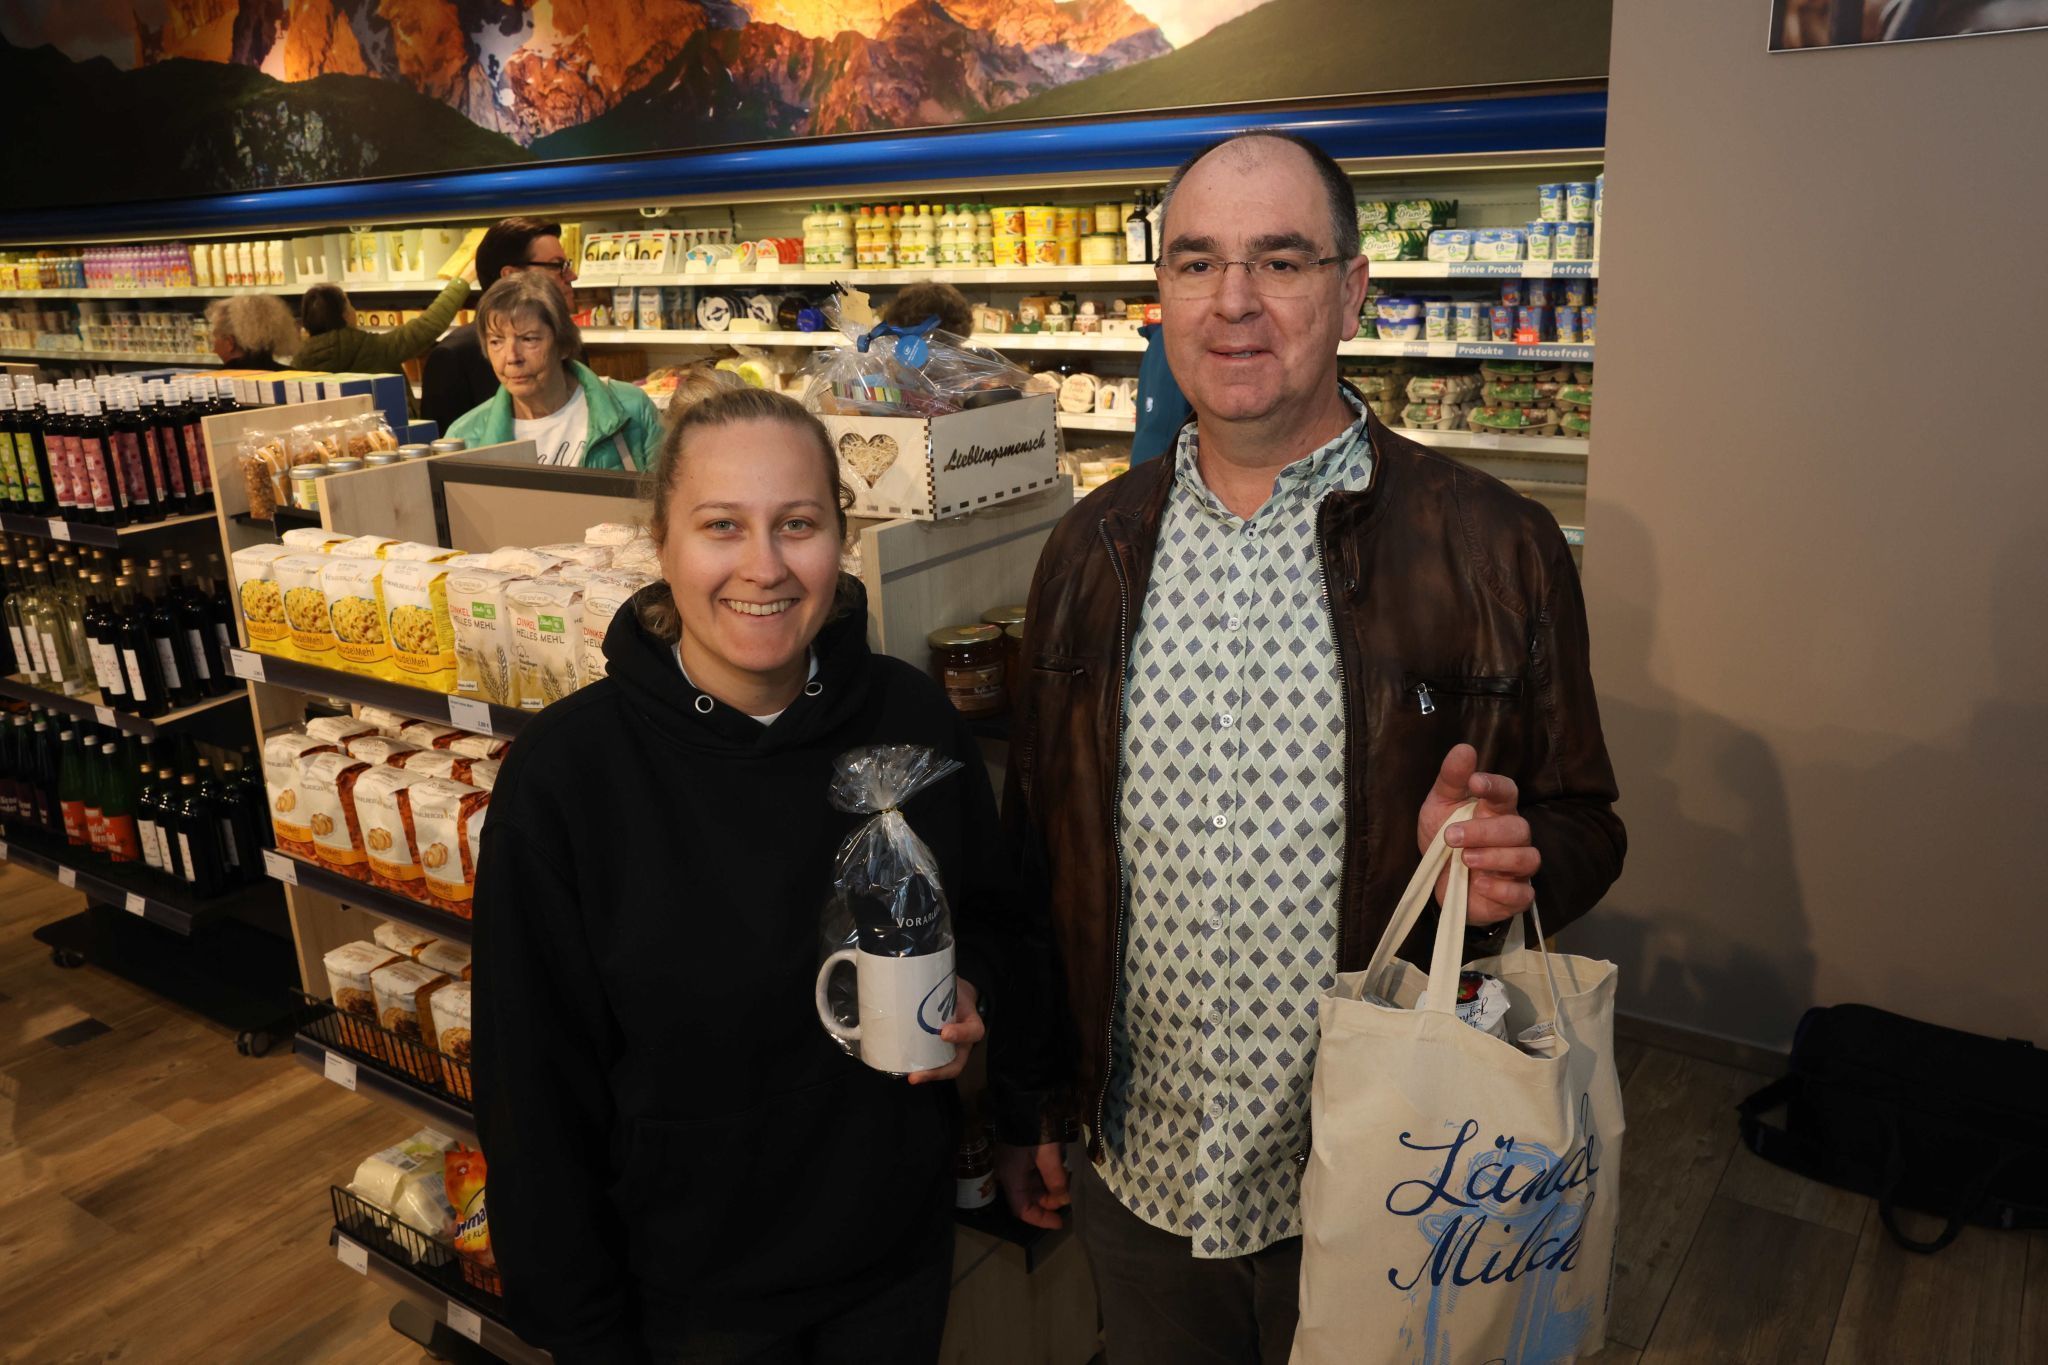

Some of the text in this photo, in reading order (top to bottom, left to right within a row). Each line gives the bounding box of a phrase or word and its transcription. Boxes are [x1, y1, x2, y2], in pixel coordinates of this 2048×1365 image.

[1396, 204, 1429, 219] Brunch
[1365, 237, 1398, 250] Brunch
[1458, 346, 1504, 356] Produkte
[1517, 346, 1590, 359] laktosefreie
[943, 429, 1046, 473] Lieblingsmensch
[449, 604, 470, 617] DINKEL
[474, 620, 496, 631] MEHL
[516, 617, 537, 631] DINKEL
[516, 629, 565, 644] HELLES MEHL
[583, 627, 605, 640] DINKE
[1388, 1191, 1594, 1290] Milch
